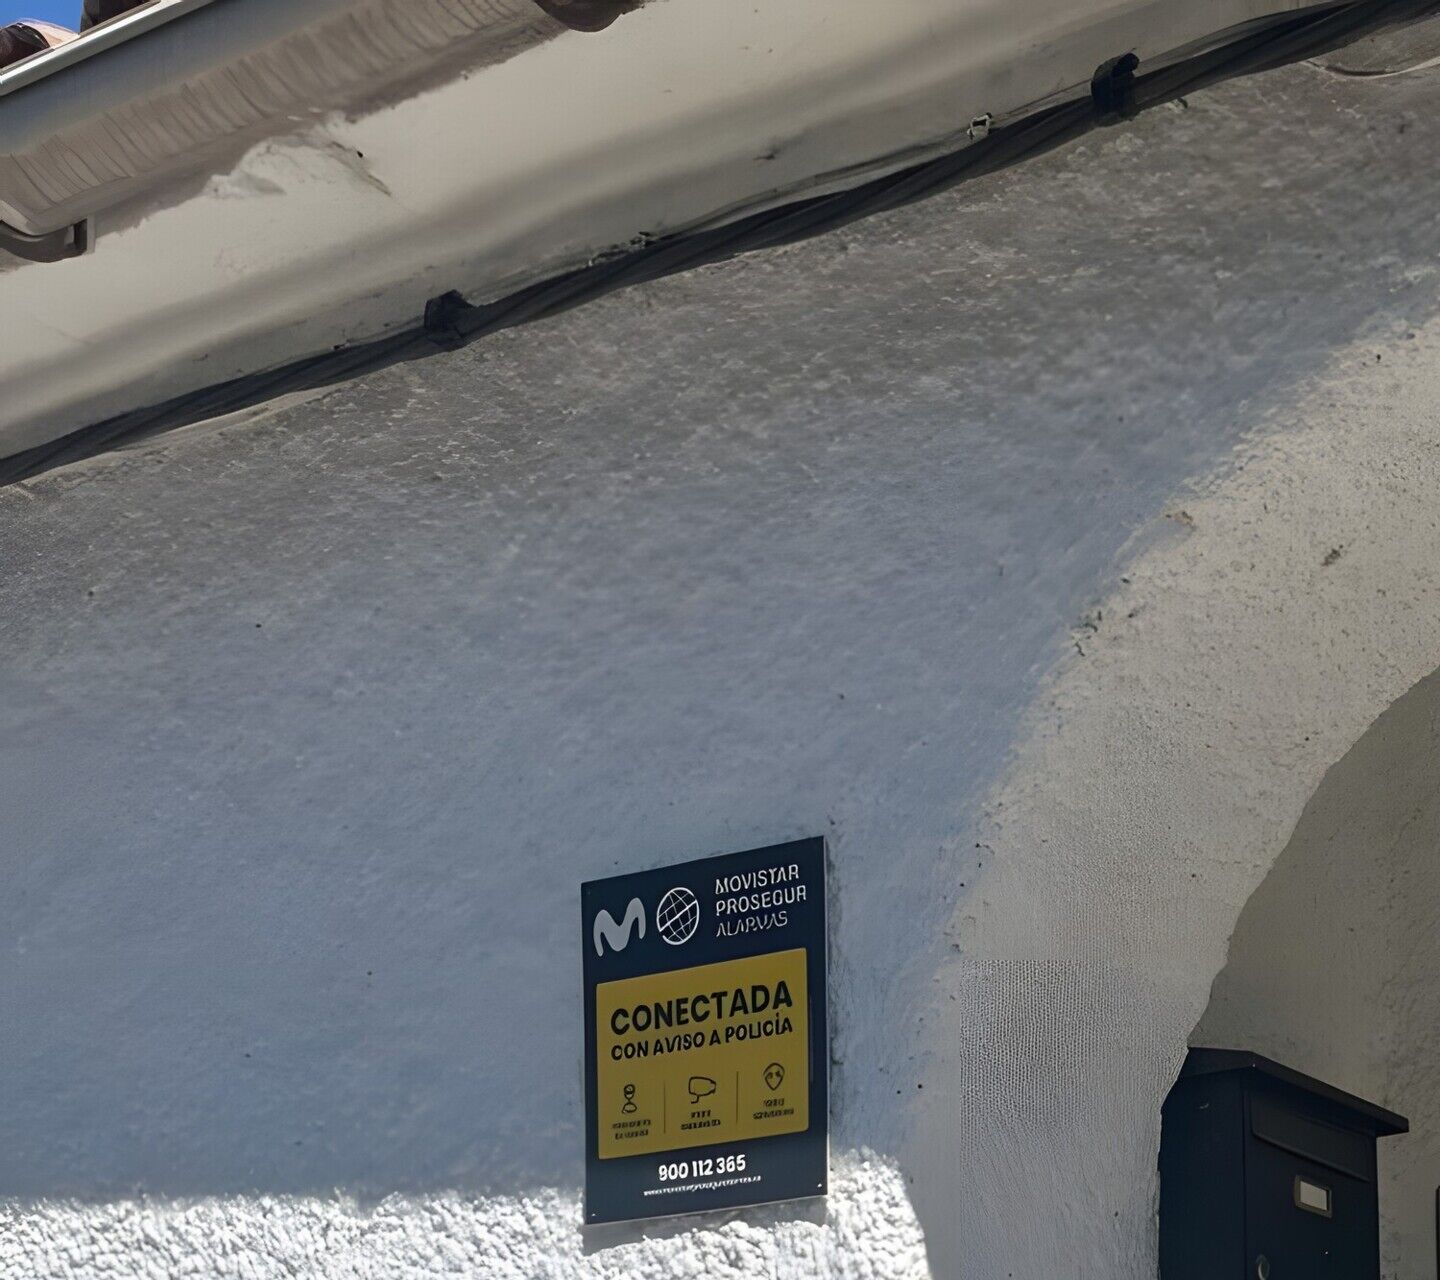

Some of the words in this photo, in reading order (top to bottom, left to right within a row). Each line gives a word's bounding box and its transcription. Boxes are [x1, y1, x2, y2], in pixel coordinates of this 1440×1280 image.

[715, 864, 799, 895] MOVISTAR
[715, 885, 806, 916] PROSEGUR
[611, 980, 793, 1036] CONECTADA
[611, 1040, 649, 1061] CON
[653, 1032, 705, 1056] AVISO
[709, 1029, 721, 1046] A
[725, 1011, 793, 1043] POLICÍA
[692, 1159, 714, 1177] 112
[716, 1154, 746, 1172] 365
